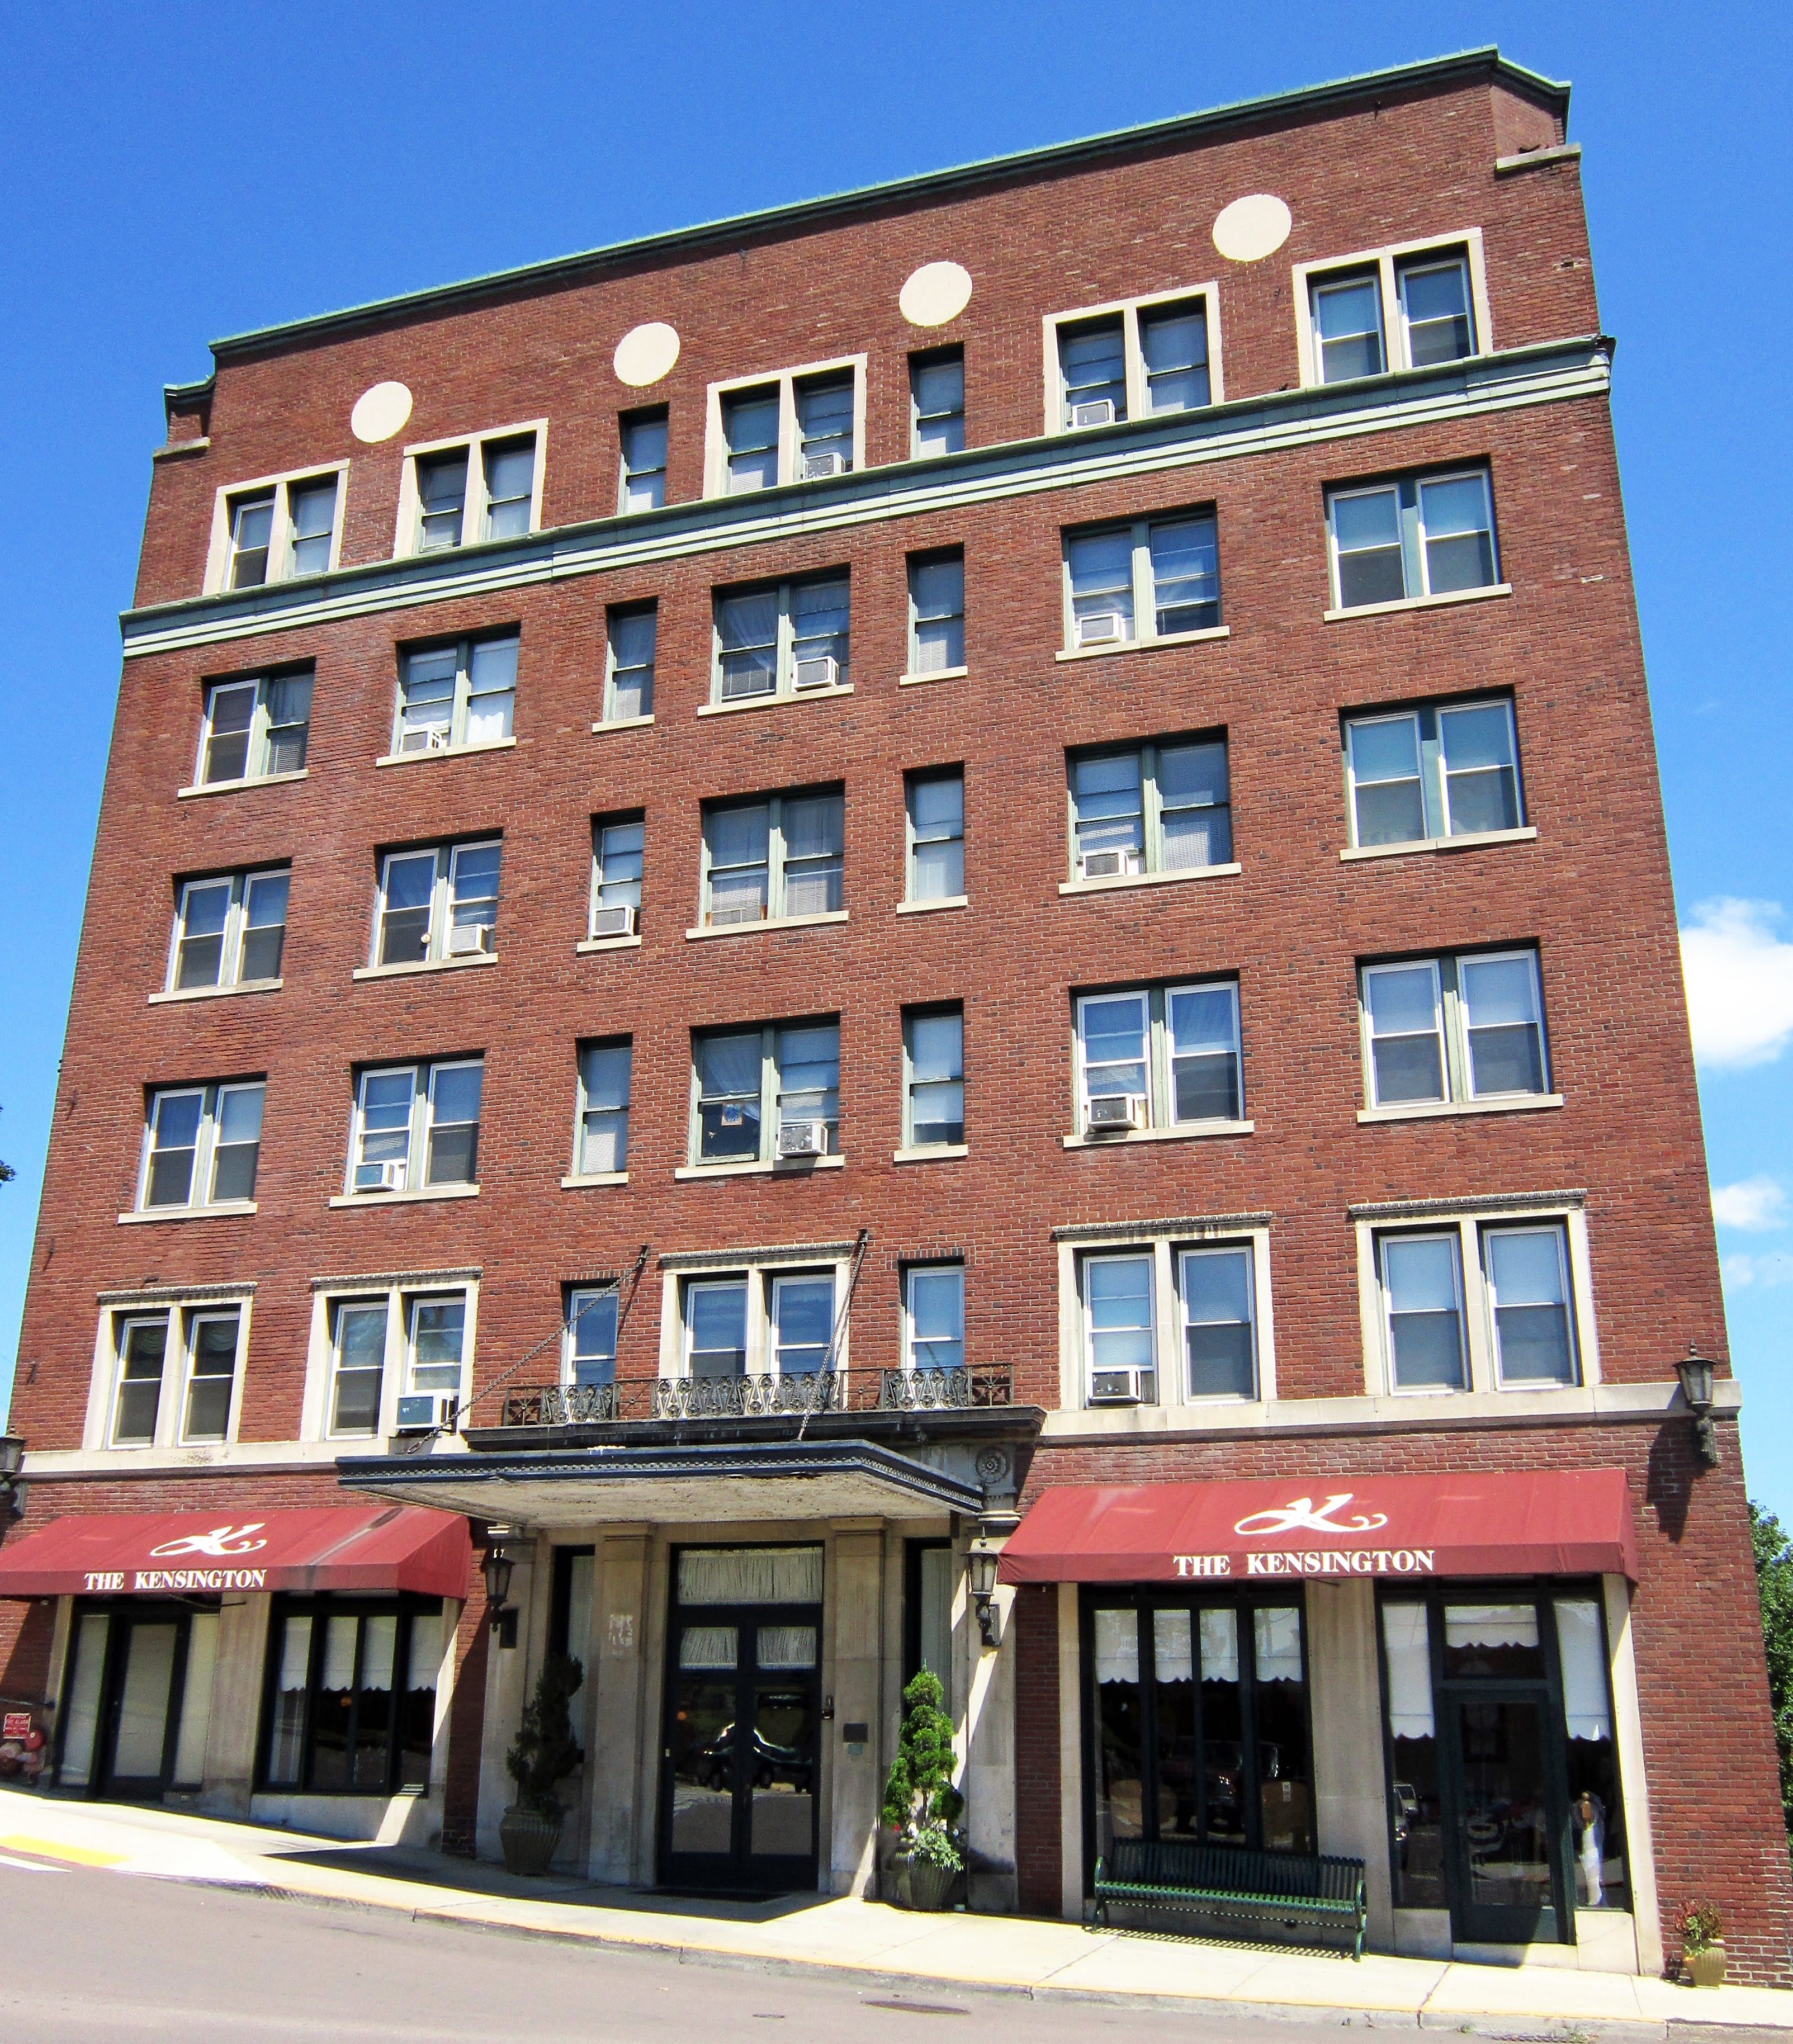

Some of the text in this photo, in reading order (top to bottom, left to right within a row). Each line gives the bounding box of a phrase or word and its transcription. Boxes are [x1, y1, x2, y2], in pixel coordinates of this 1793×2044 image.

[1173, 1550, 1435, 1577] THE KENSINGTON
[84, 1569, 267, 1591] THE KENSINGTON
